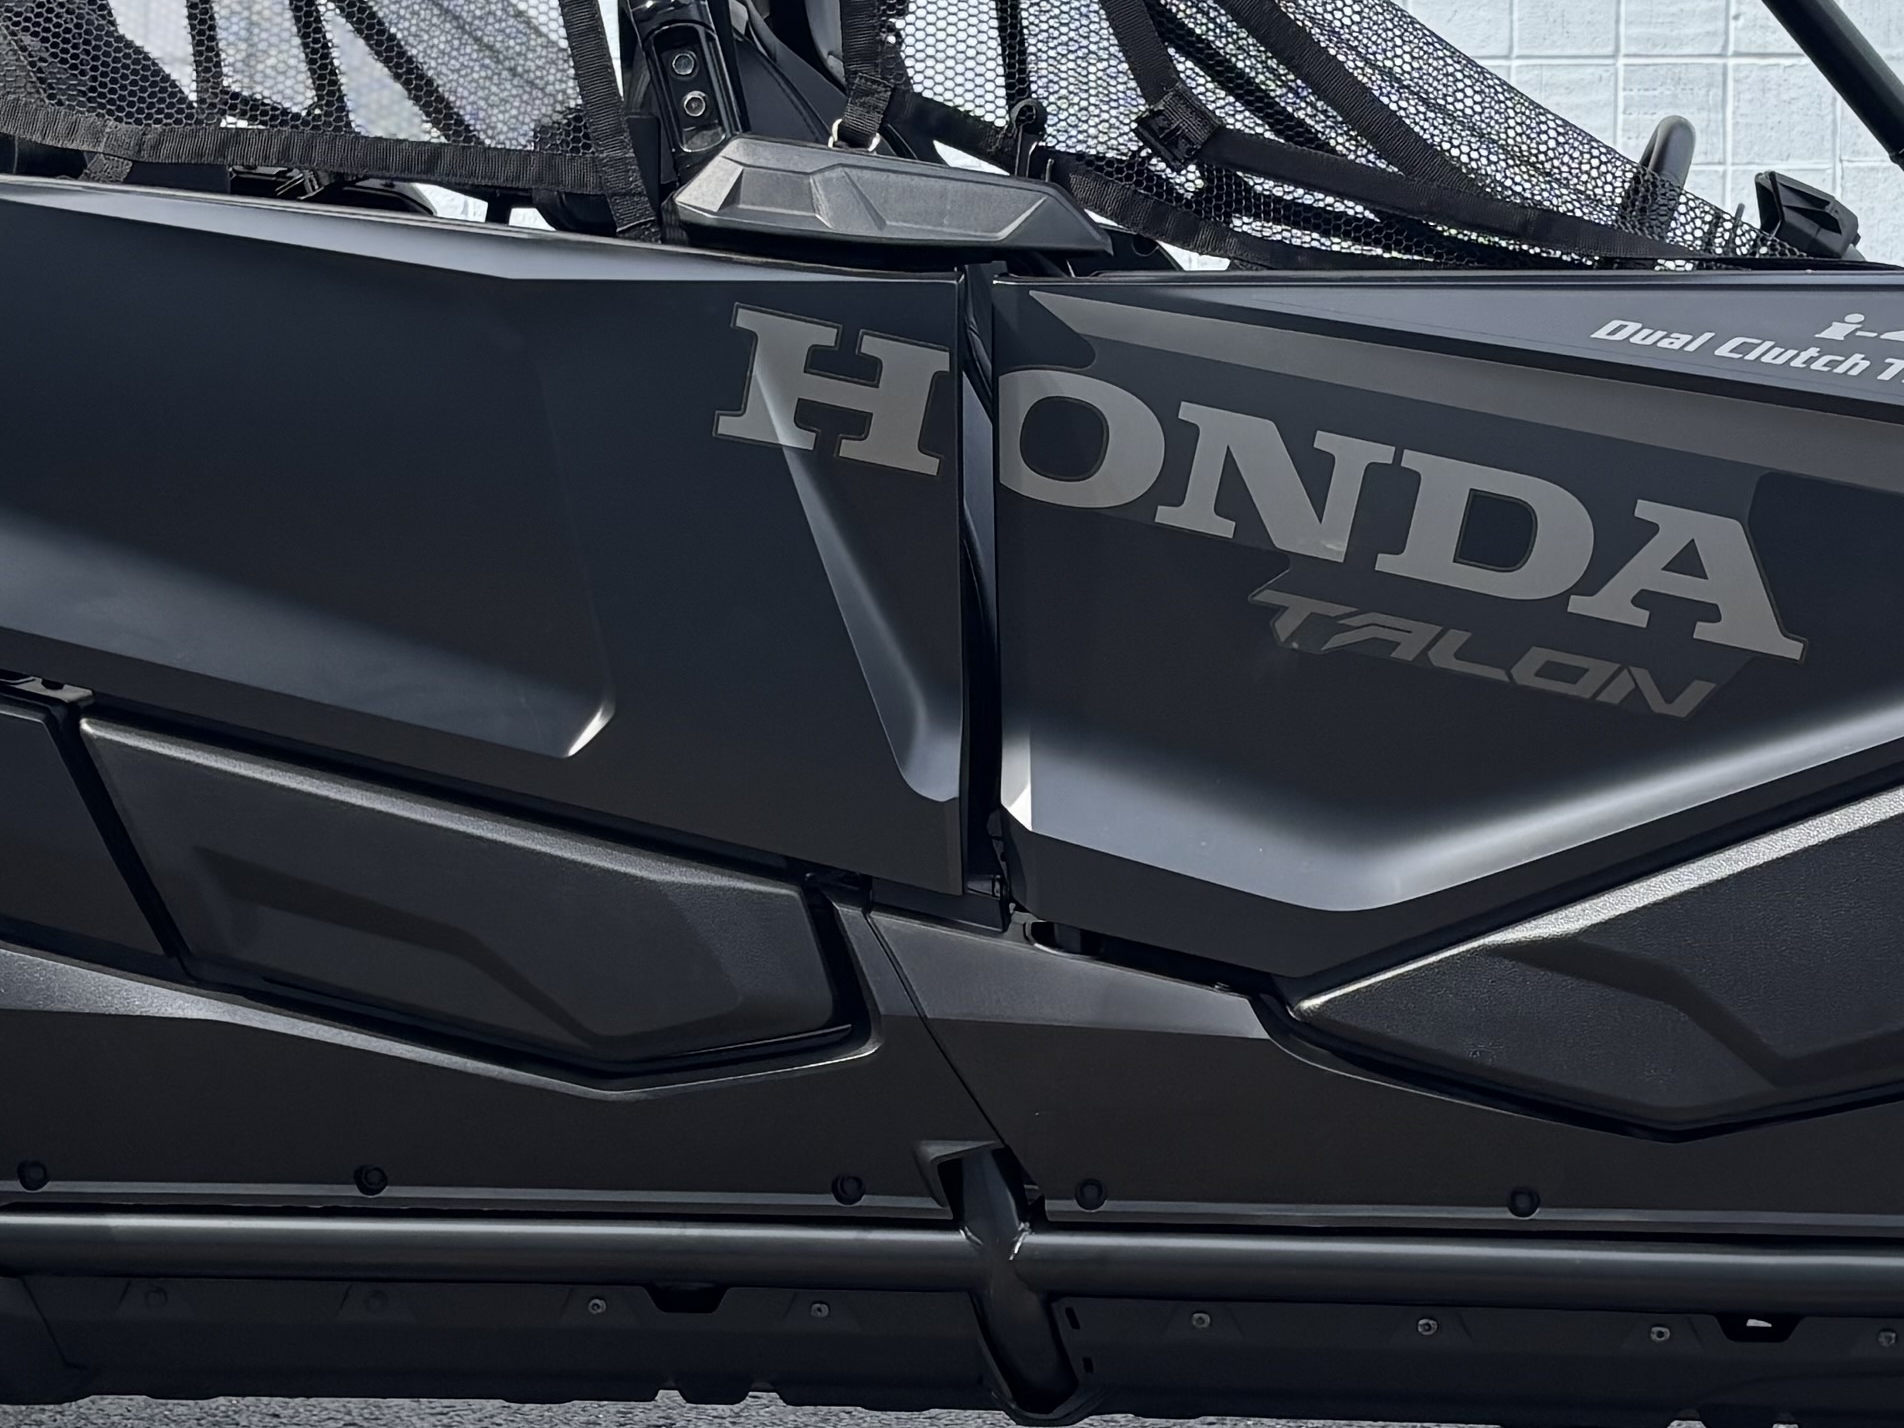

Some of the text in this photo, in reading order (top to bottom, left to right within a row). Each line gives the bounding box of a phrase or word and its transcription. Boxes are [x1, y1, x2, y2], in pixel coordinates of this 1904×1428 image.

[1591, 319, 1714, 353] Dual
[1714, 335, 1872, 376] Clutch
[712, 305, 1807, 662] HONDA
[1251, 588, 1717, 719] TALON
